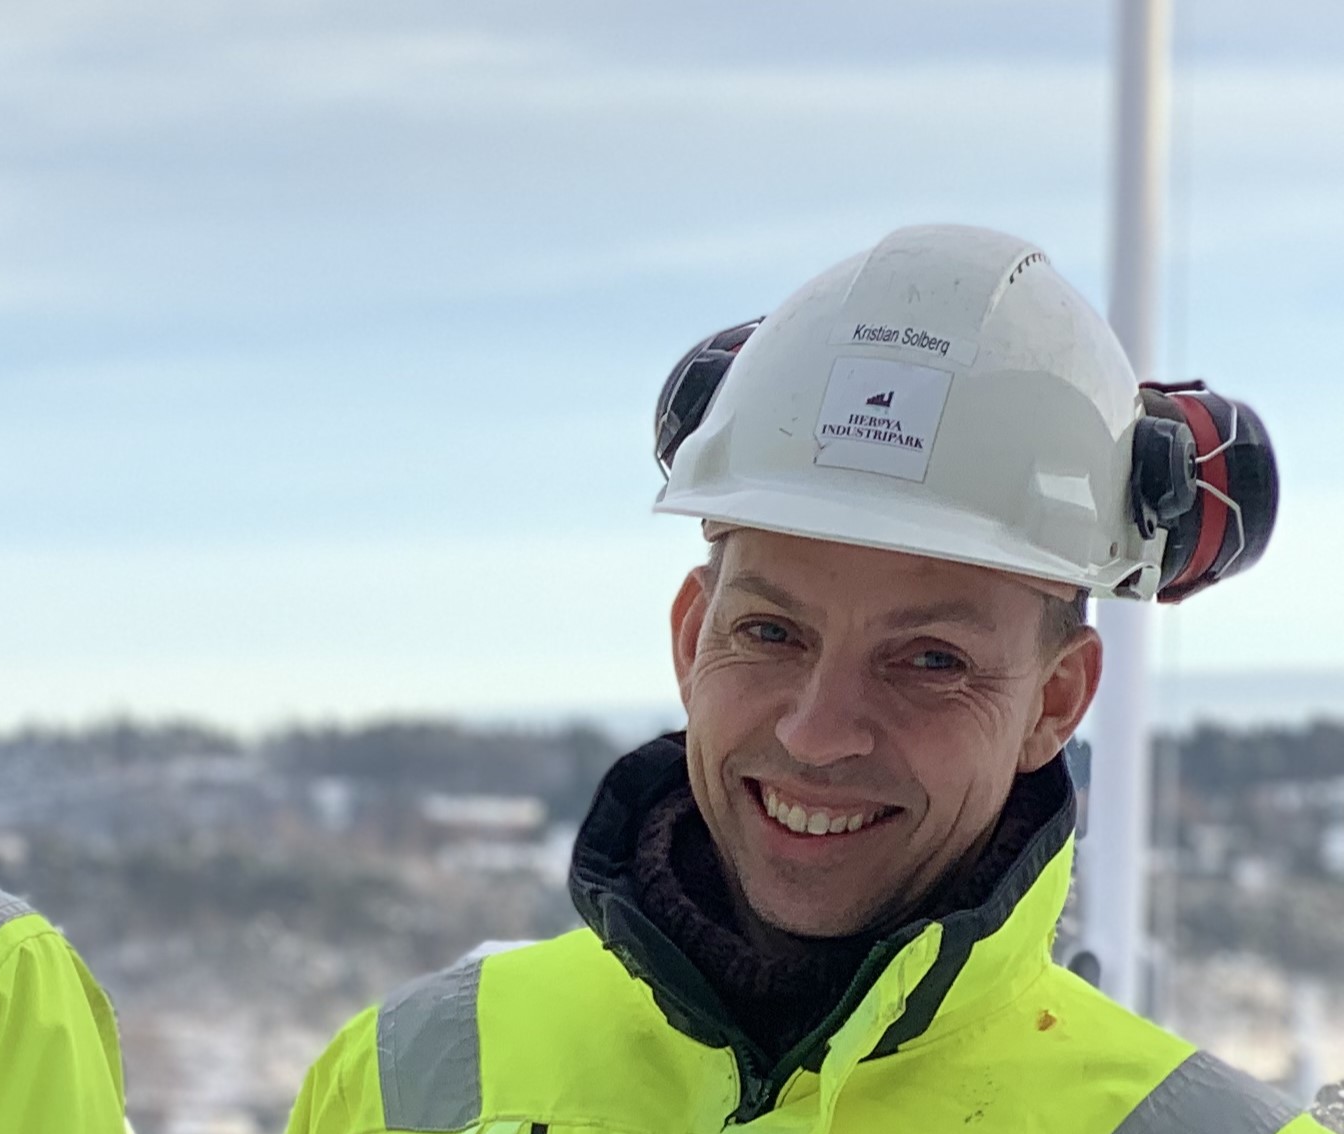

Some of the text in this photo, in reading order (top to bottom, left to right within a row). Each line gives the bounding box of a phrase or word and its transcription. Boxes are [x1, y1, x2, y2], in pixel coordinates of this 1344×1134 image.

[852, 324, 951, 356] Kristian Solberg
[821, 423, 925, 449] INDUSTRIPARK
